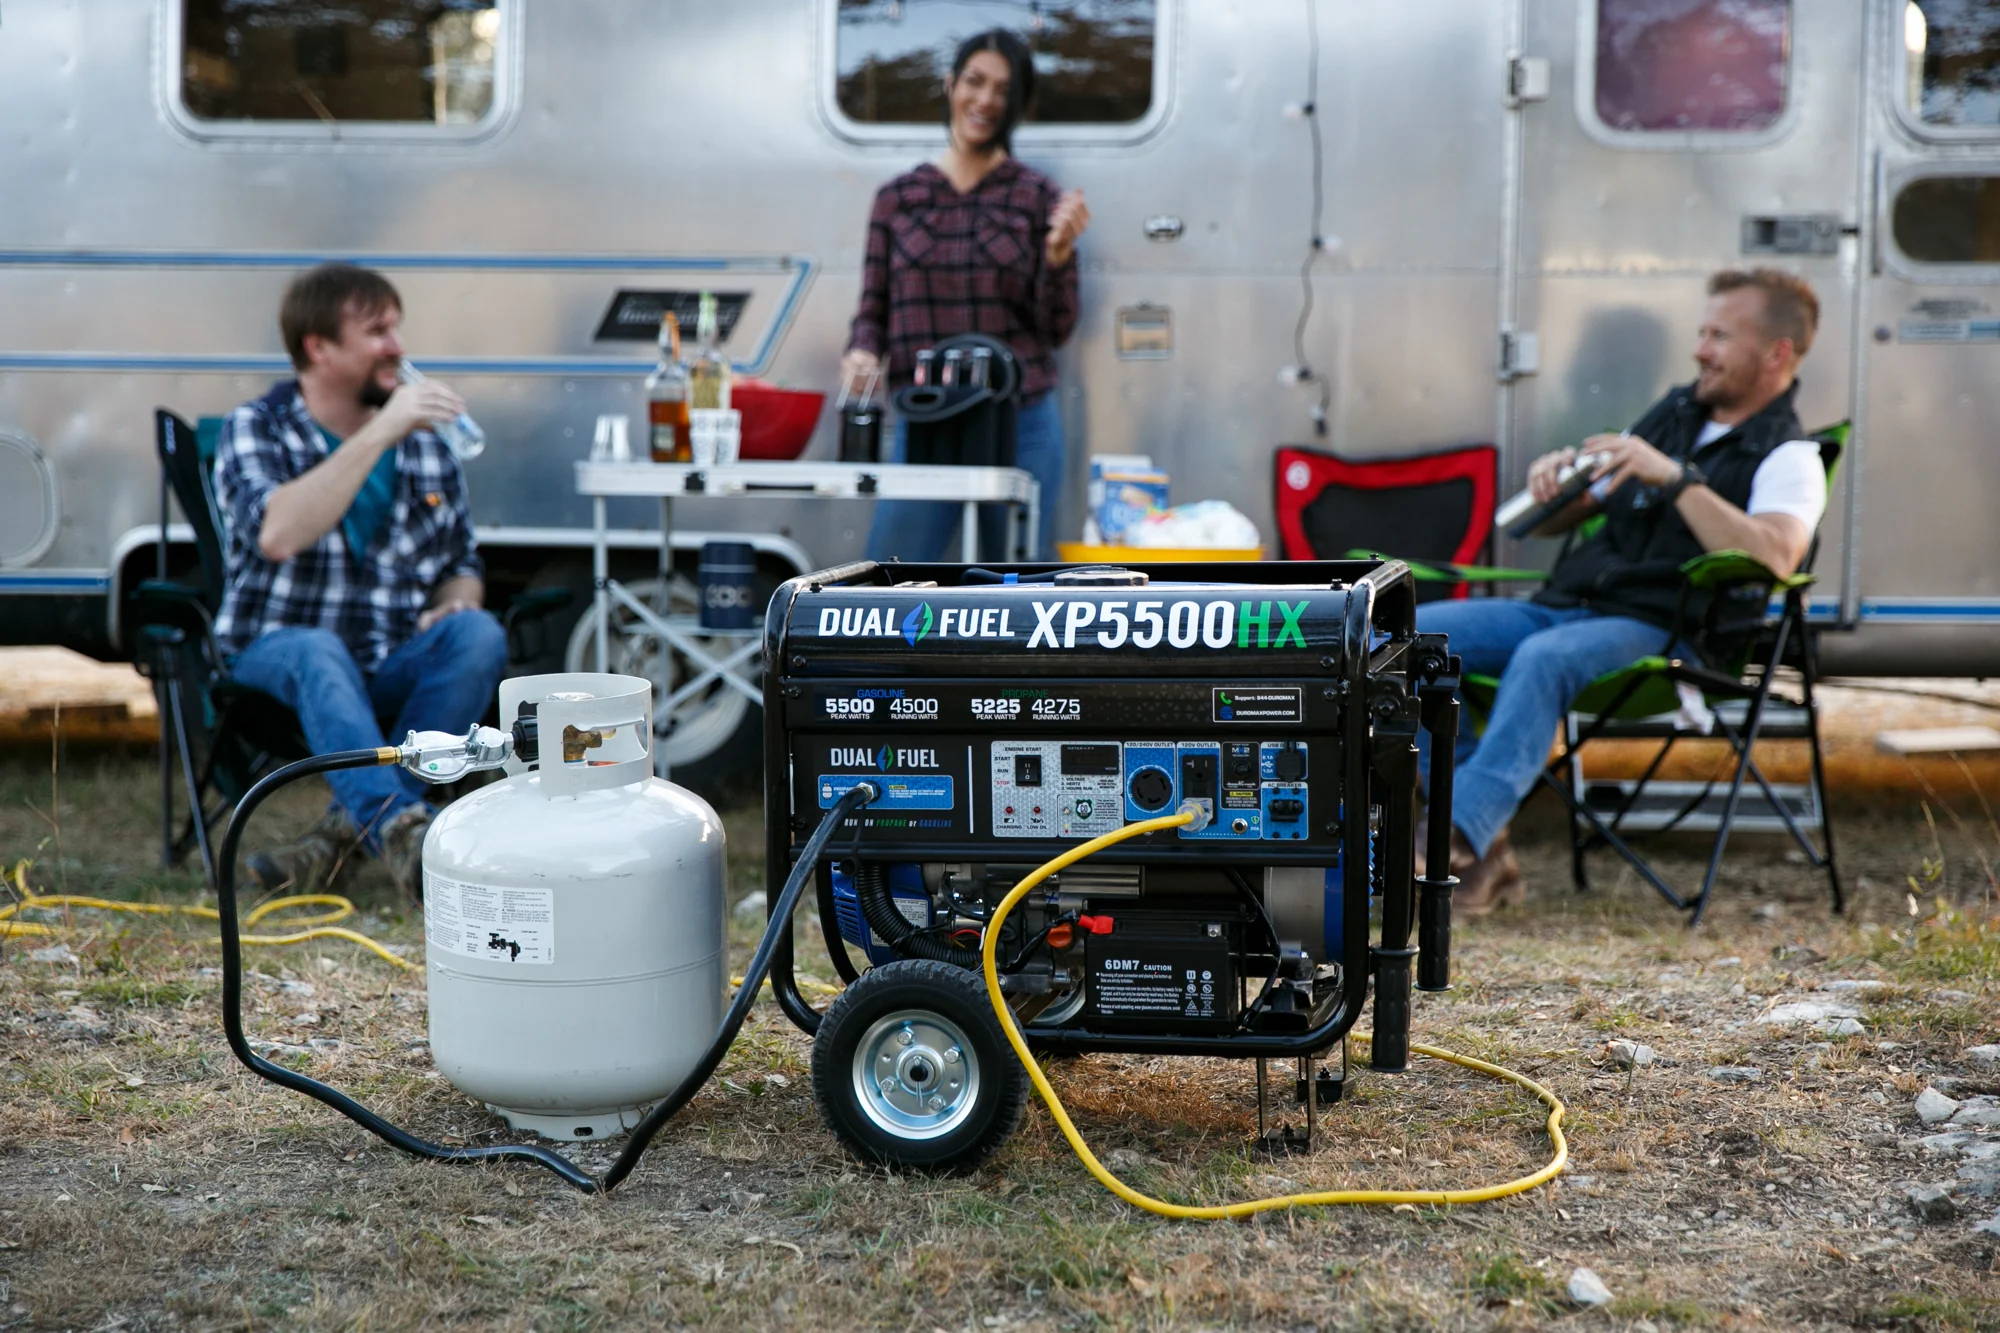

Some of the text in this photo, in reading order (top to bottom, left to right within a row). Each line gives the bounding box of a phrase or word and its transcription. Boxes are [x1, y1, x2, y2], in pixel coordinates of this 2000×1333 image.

[818, 601, 1310, 648] DUAL FUEL XP5500HX
[857, 689, 906, 698] GASOLINE
[1001, 689, 1049, 699] PROPANE
[826, 699, 938, 713] 5500 4500
[971, 699, 1080, 714] 5225 4275
[830, 748, 939, 767] DUAL FUEL
[844, 819, 858, 827] RUN
[865, 819, 874, 827] ON
[876, 819, 906, 827] PROPANE
[1105, 959, 1139, 970] 6DM7
